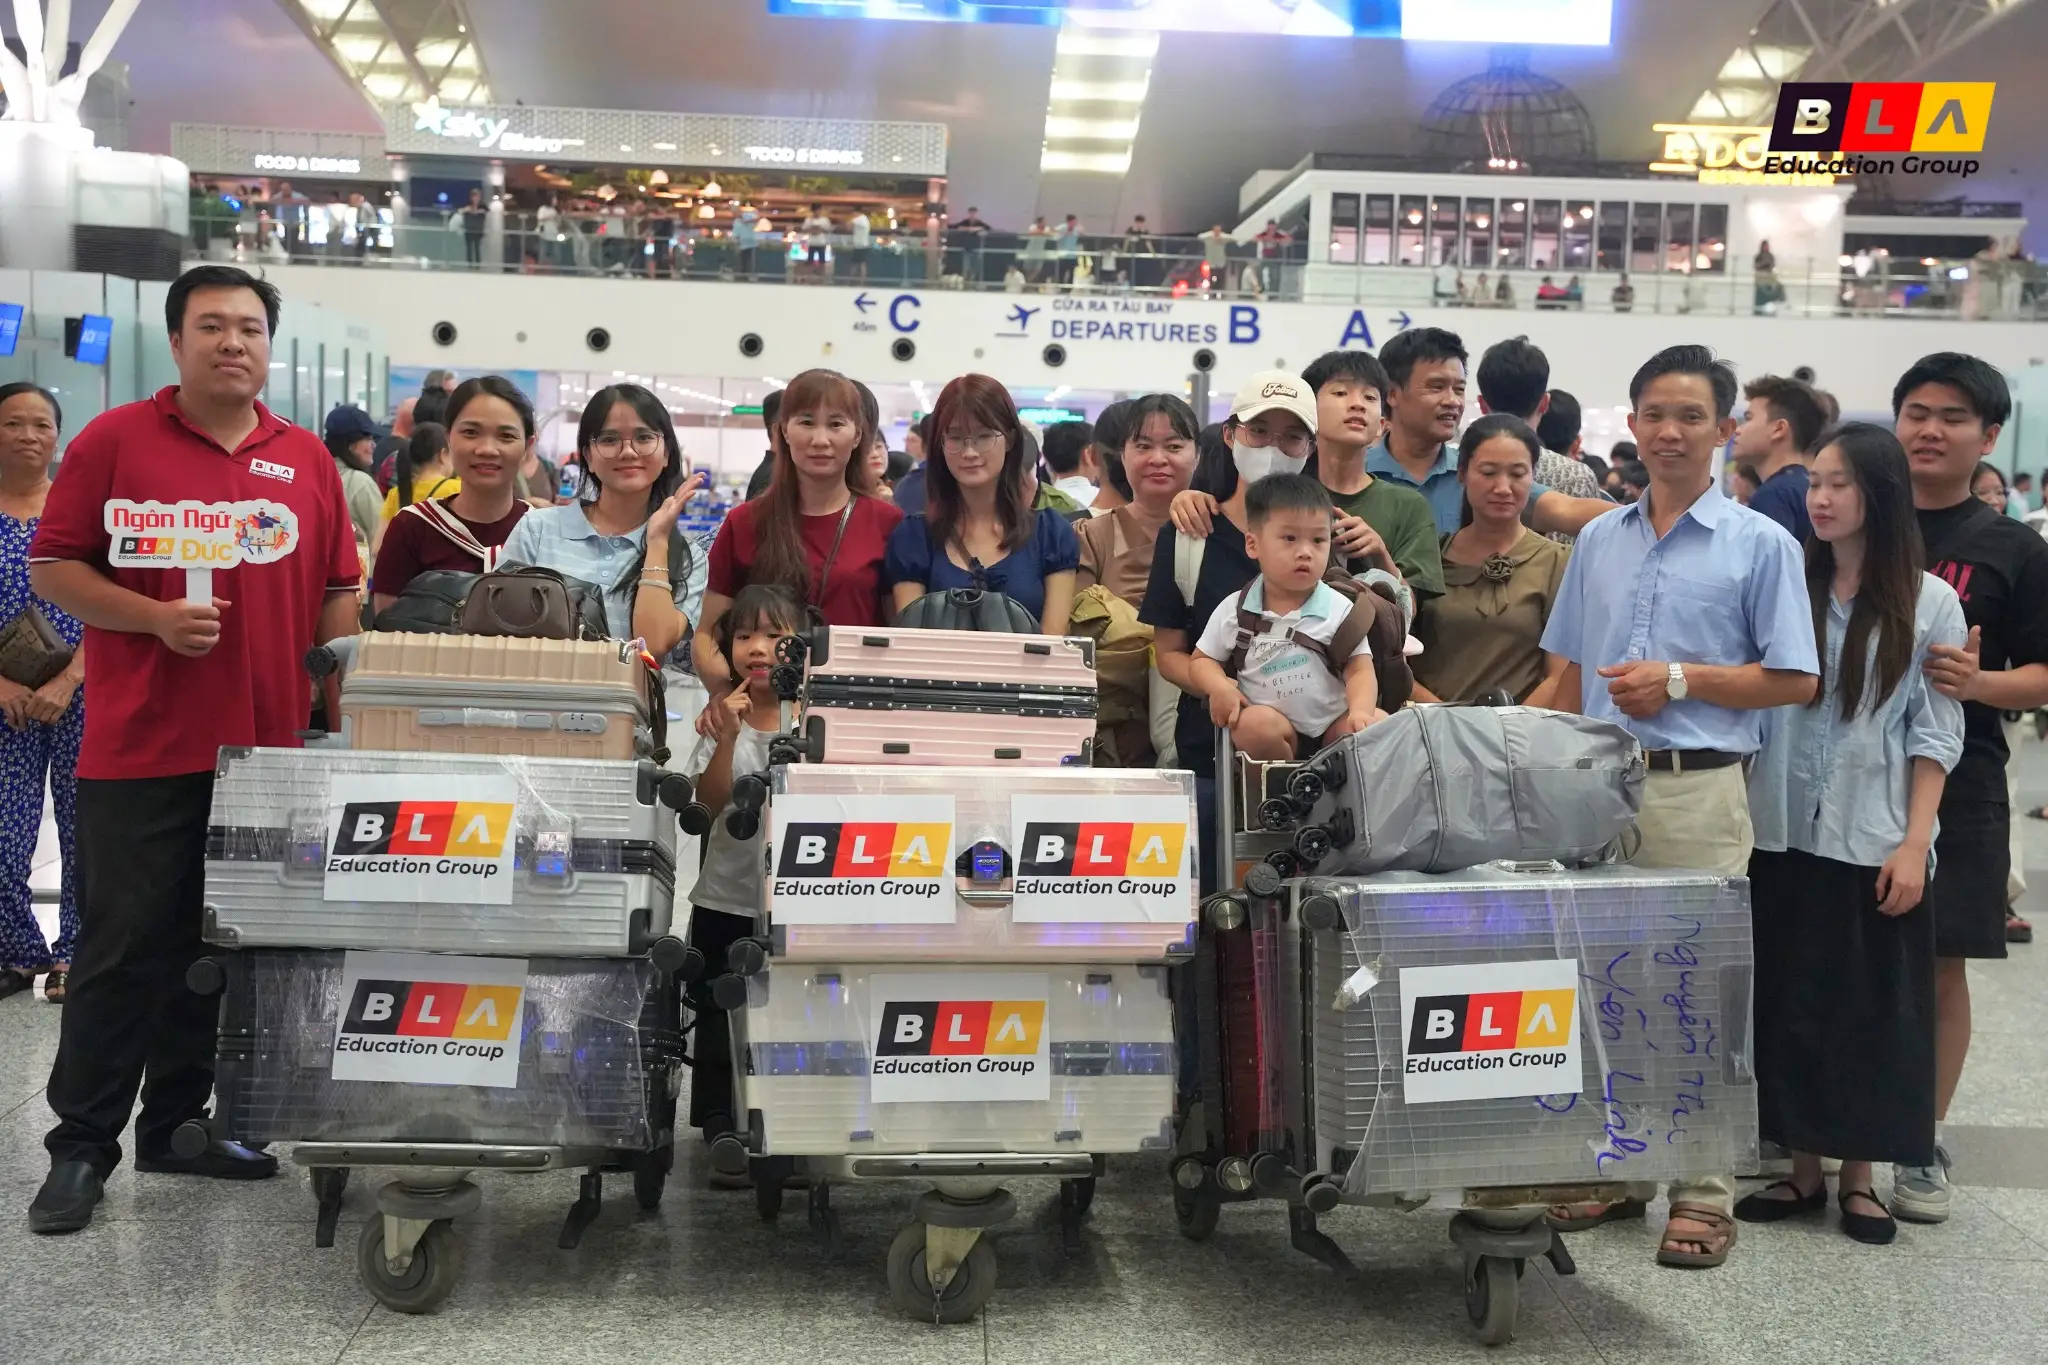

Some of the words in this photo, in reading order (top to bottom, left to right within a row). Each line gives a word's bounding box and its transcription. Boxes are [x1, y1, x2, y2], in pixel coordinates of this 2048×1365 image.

[889, 294, 920, 332] C
[1088, 300, 1107, 311] RA
[1146, 303, 1173, 314] BAY
[1051, 320, 1218, 343] DEPARTURES
[1229, 306, 1260, 344] B
[1339, 309, 1374, 348] A
[249, 468, 276, 480] Education
[255, 462, 290, 476] BLA
[114, 508, 174, 532] Ngôn
[184, 510, 232, 532] Ngữ
[124, 540, 168, 550] BLA
[180, 538, 232, 560] Đức
[352, 813, 490, 844] BLA
[796, 836, 932, 864] BLA
[1036, 835, 1167, 864] BLA
[328, 858, 430, 874] Education
[436, 860, 498, 878] Group
[774, 880, 874, 896] Education
[880, 880, 940, 898] Group
[1015, 879, 1113, 894] Education
[1118, 880, 1176, 897] Group
[362, 992, 498, 1026] BLA
[894, 1014, 1026, 1042] BLA
[1426, 1003, 1557, 1040] BLA
[336, 1036, 438, 1054] Education
[443, 1042, 504, 1060] Group
[873, 1058, 972, 1074] Education
[977, 1058, 1034, 1075] Group
[1406, 1054, 1504, 1074] Education
[1509, 1052, 1566, 1068] Group
